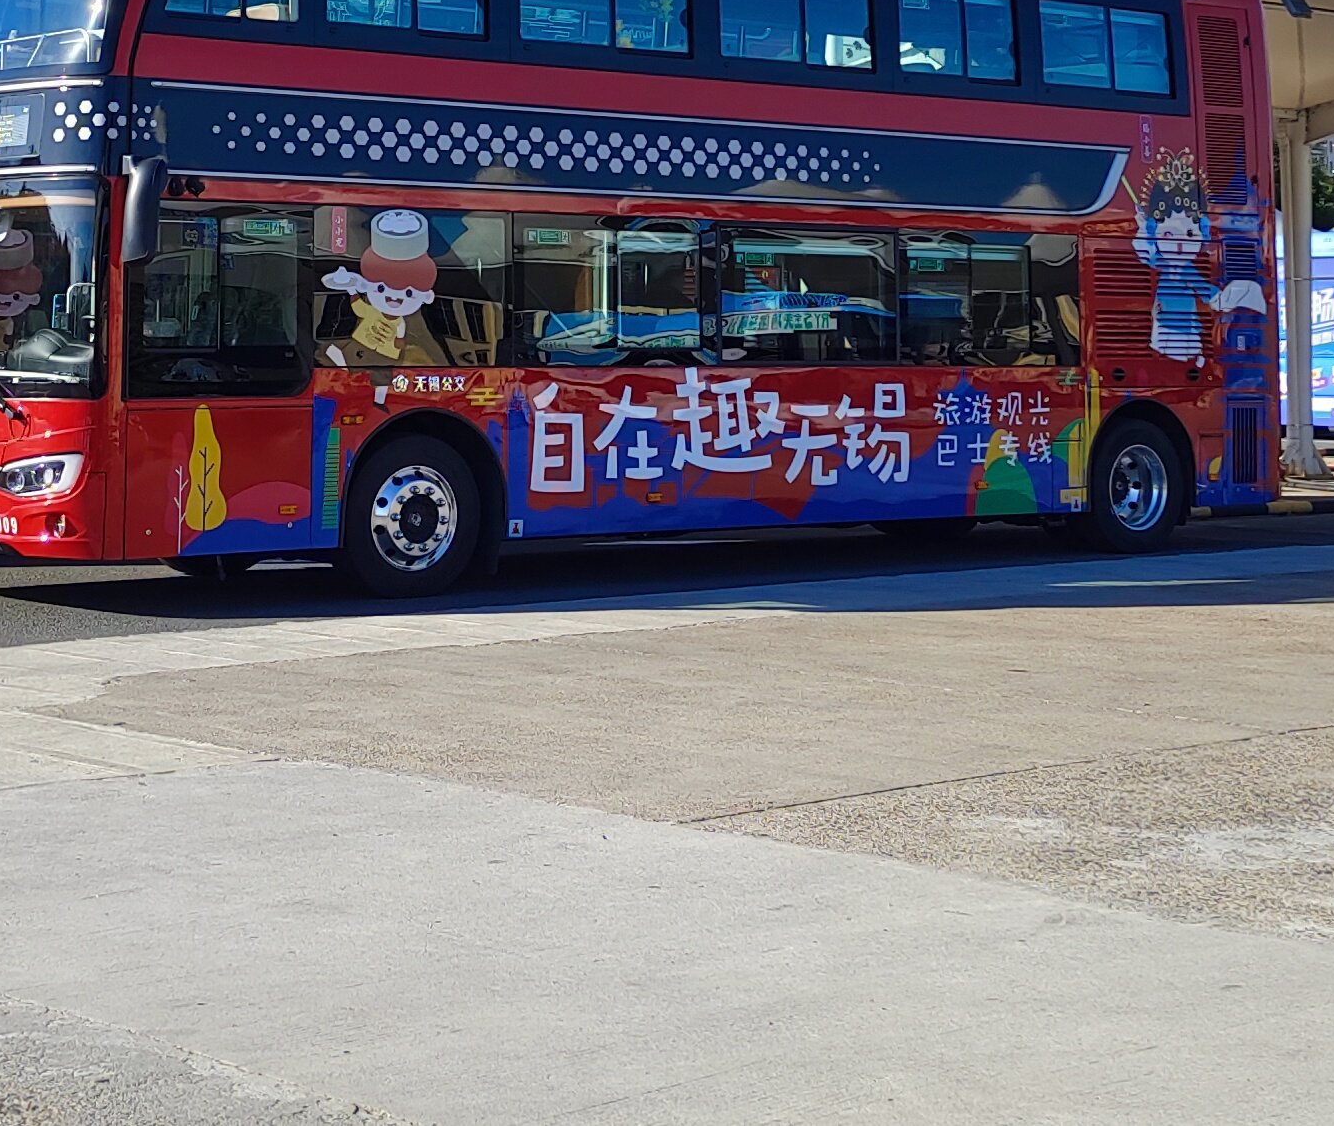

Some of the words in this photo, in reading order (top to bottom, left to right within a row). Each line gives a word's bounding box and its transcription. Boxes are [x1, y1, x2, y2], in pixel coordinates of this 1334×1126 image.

[413, 375, 466, 392] 无锡公交
[932, 390, 1051, 426] 旅游观光
[529, 366, 911, 493] 自在趣无锡
[937, 431, 1052, 467] 巴士专线
